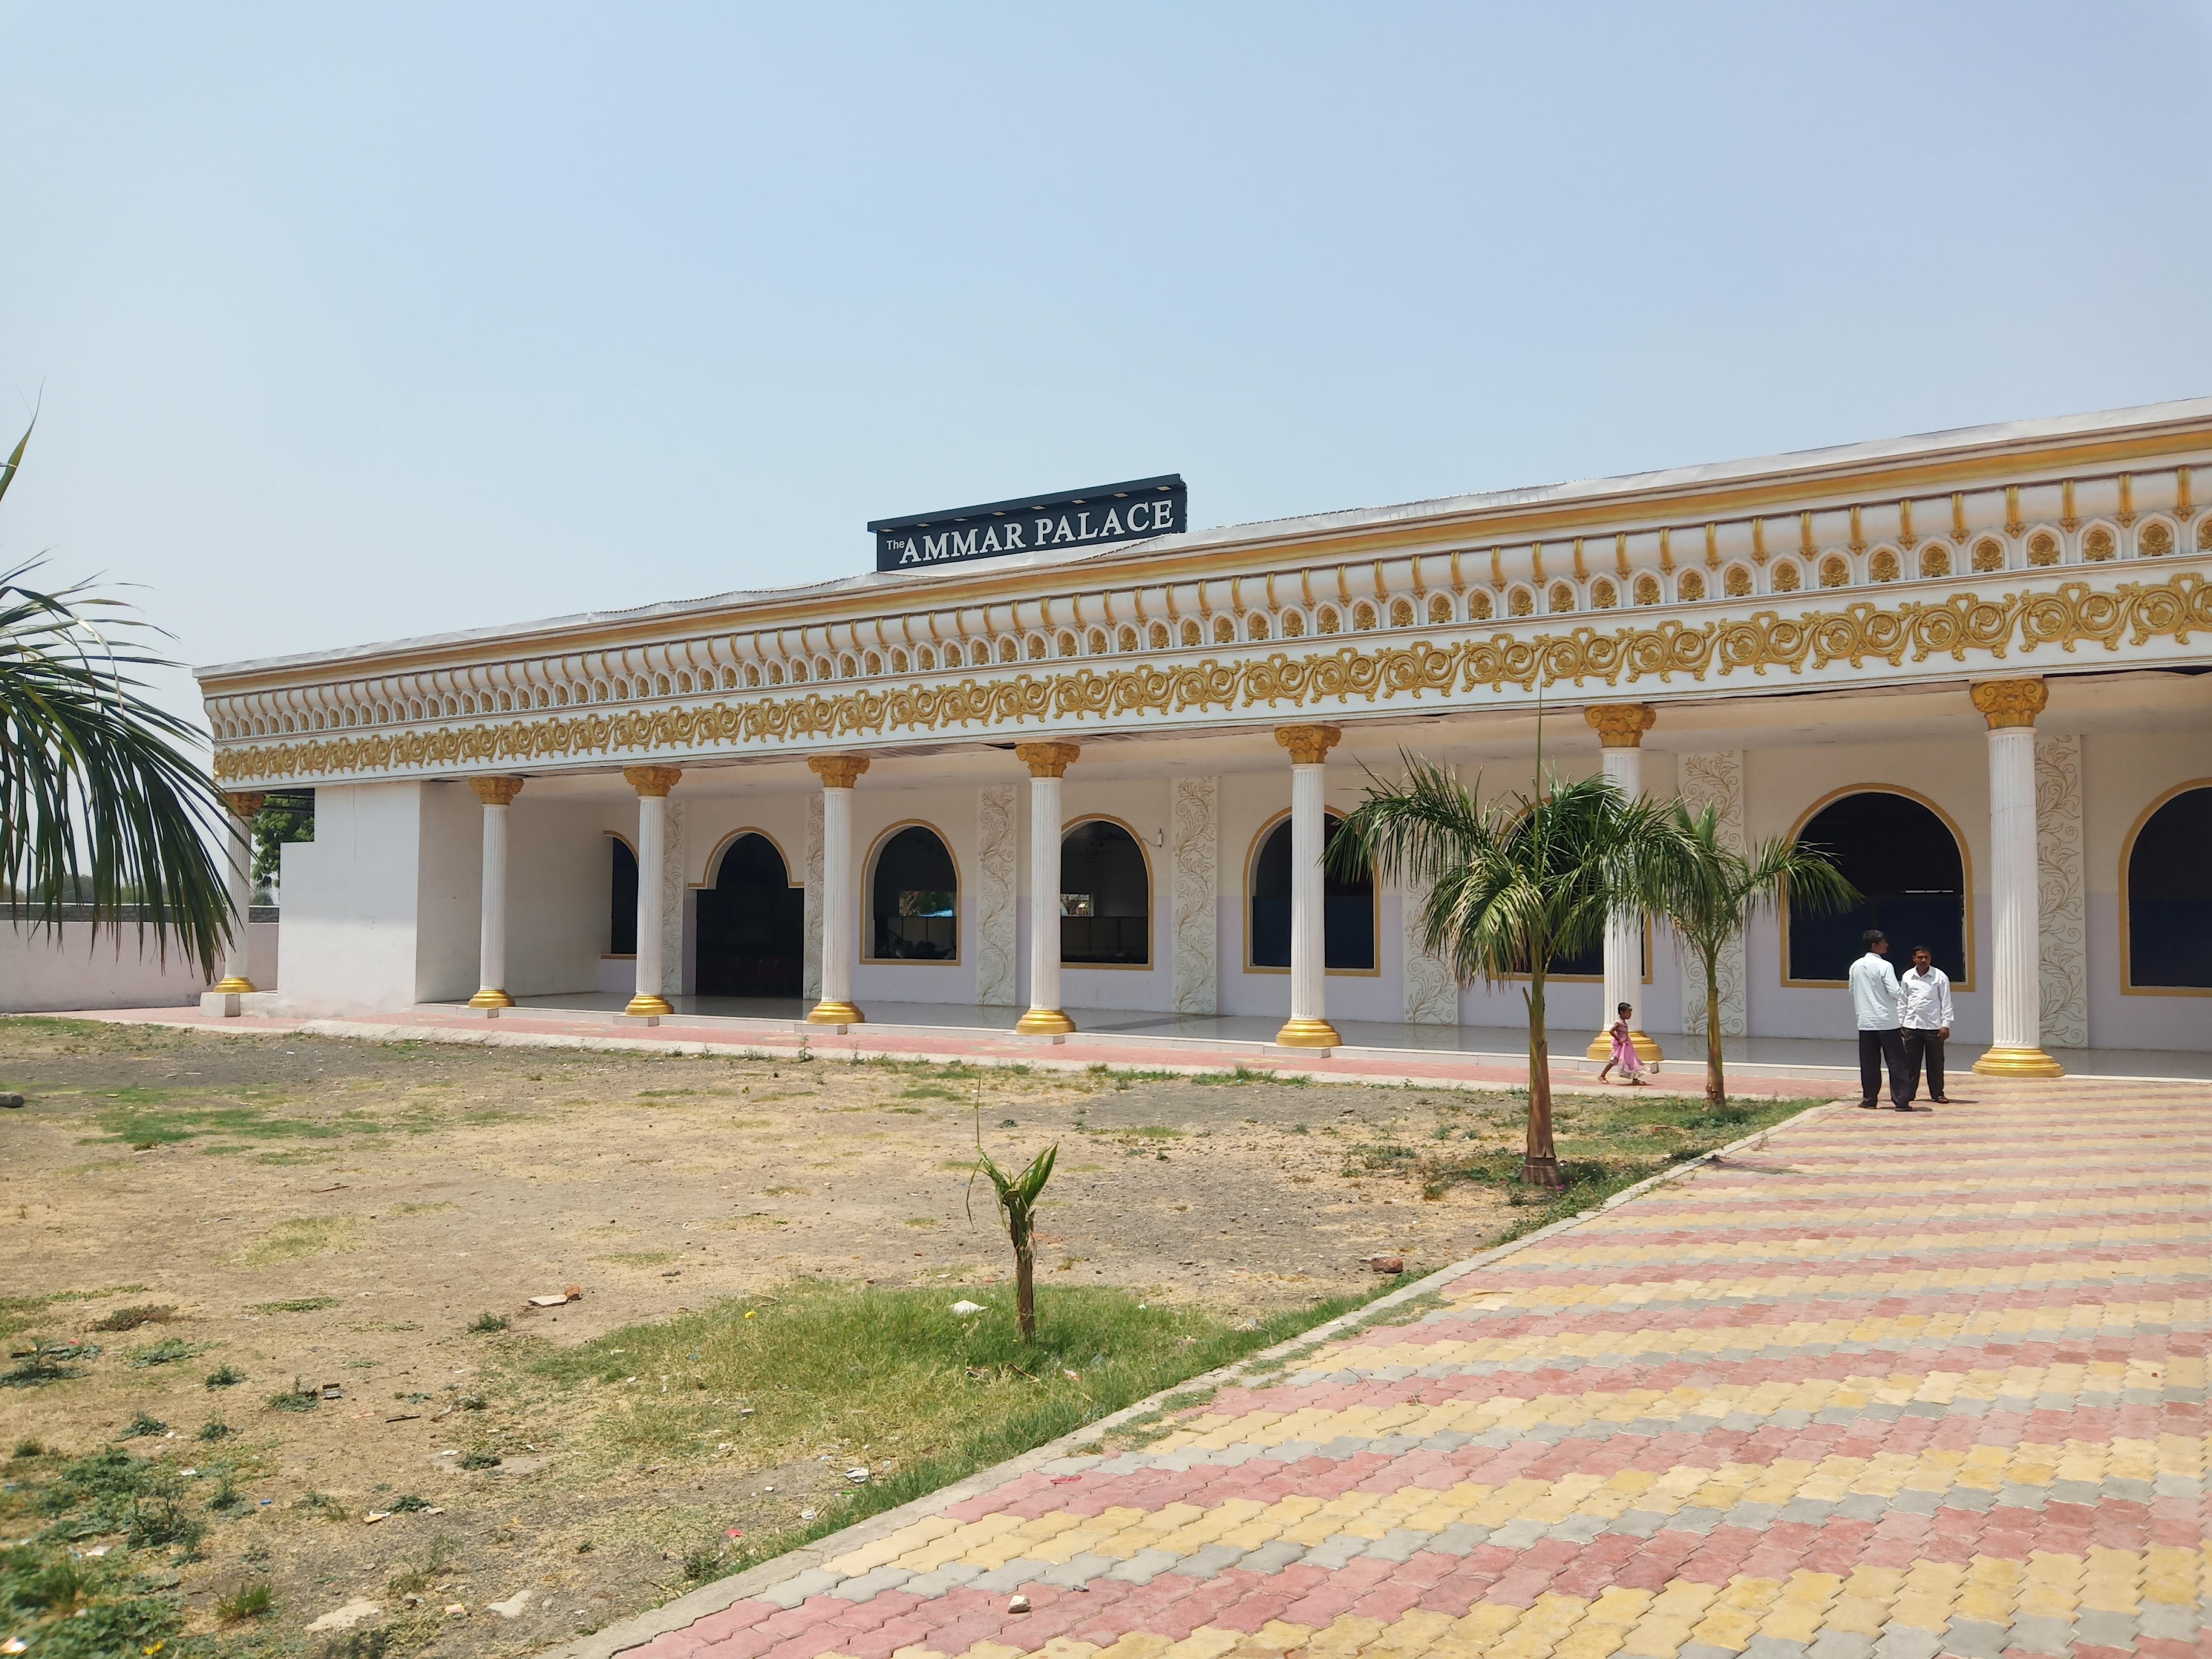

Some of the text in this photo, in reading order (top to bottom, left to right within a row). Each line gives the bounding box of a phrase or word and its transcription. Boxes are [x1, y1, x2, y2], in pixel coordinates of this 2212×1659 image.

[887, 499, 1175, 565] The AMMAR PALACE
